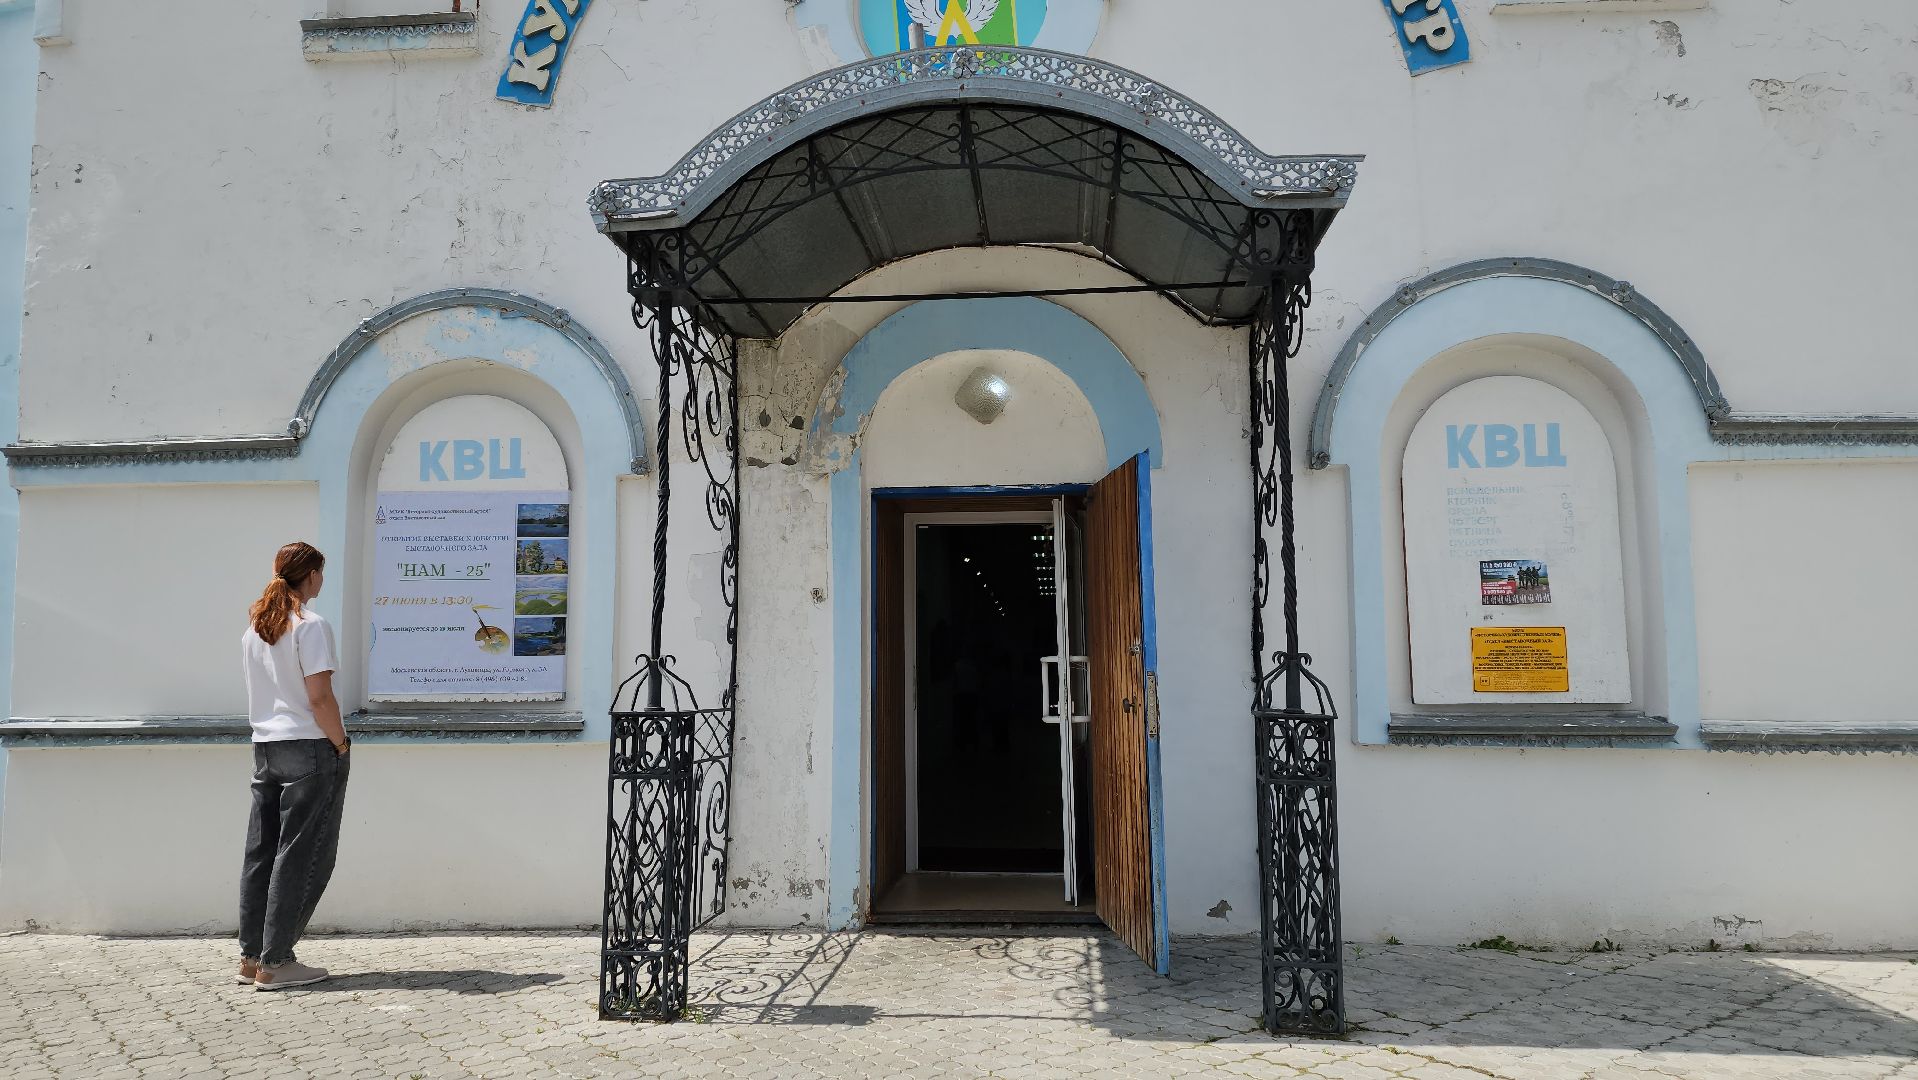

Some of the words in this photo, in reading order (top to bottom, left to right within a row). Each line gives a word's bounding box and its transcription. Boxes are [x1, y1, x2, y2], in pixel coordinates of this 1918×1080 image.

[507, 0, 581, 92] КУ
[419, 437, 526, 481] КВЦ
[1445, 422, 1568, 469] КВЦ
[397, 562, 446, 577] "НАМ
[466, 562, 491, 577] 25"
[374, 596, 389, 606] 27
[391, 597, 427, 606] июня
